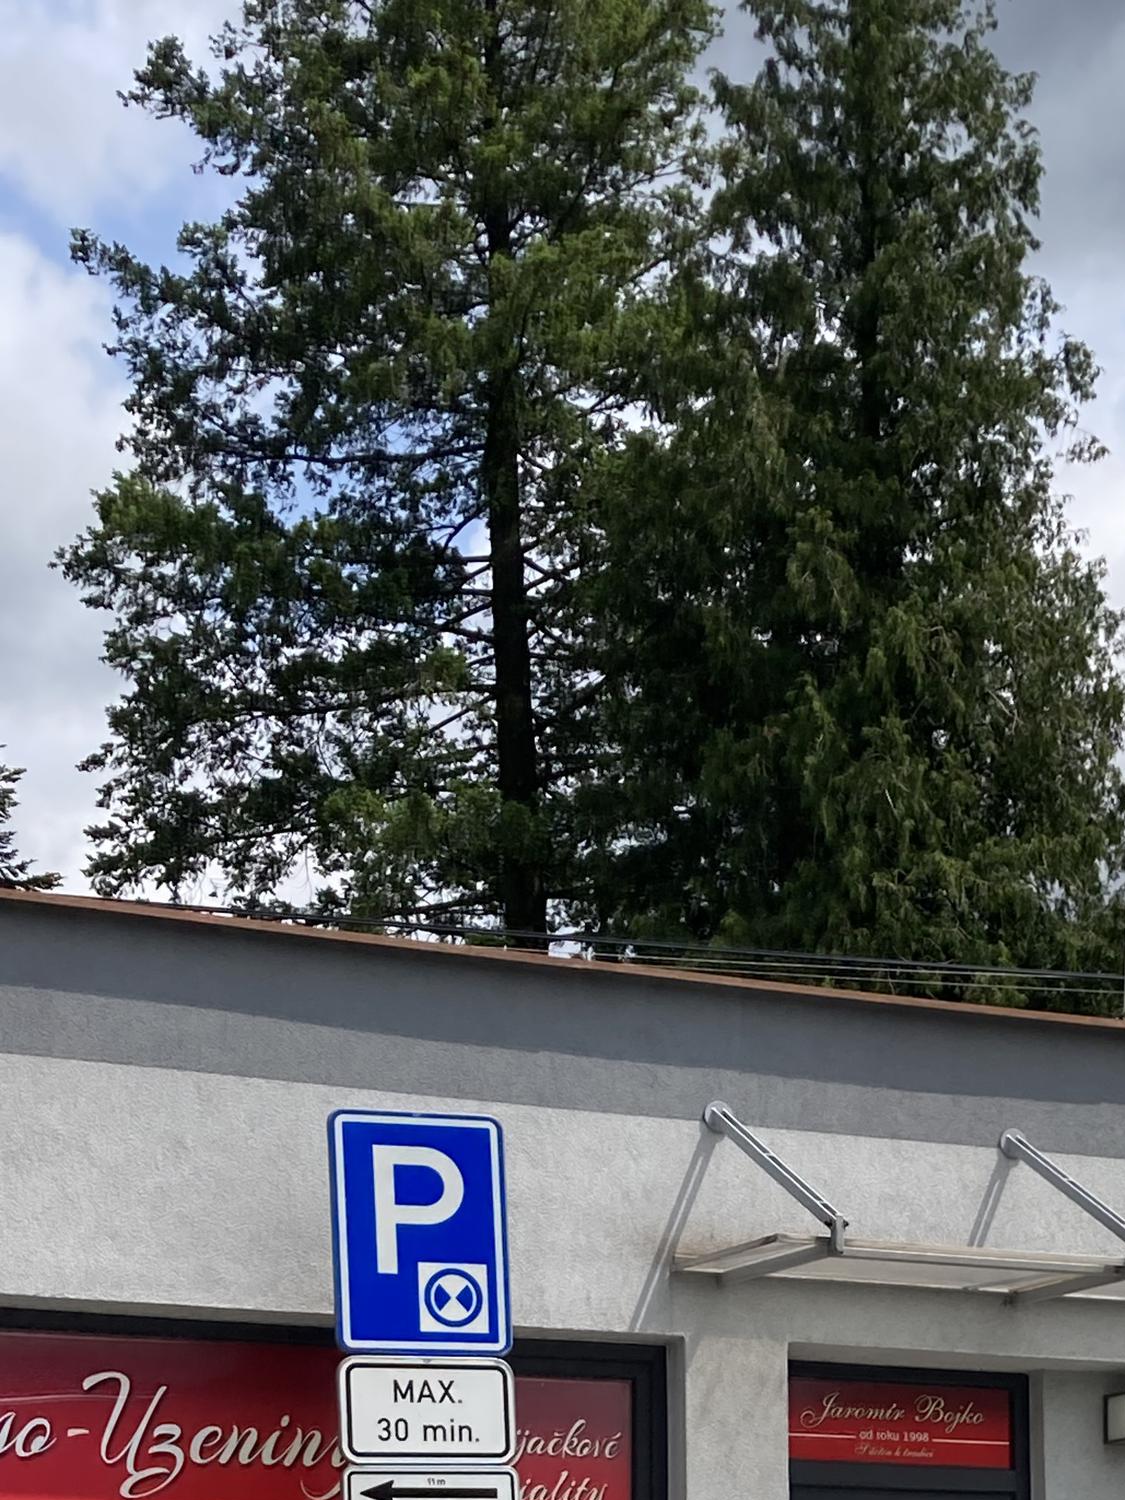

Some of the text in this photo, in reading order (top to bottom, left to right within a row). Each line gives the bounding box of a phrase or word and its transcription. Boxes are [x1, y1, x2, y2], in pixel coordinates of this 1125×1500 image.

[372, 1144, 464, 1275] P
[393, 1379, 462, 1404] MAX.
[800, 1391, 985, 1433] Jaromír Bojko
[377, 1417, 480, 1443] 30 min.
[859, 1430, 873, 1440] od
